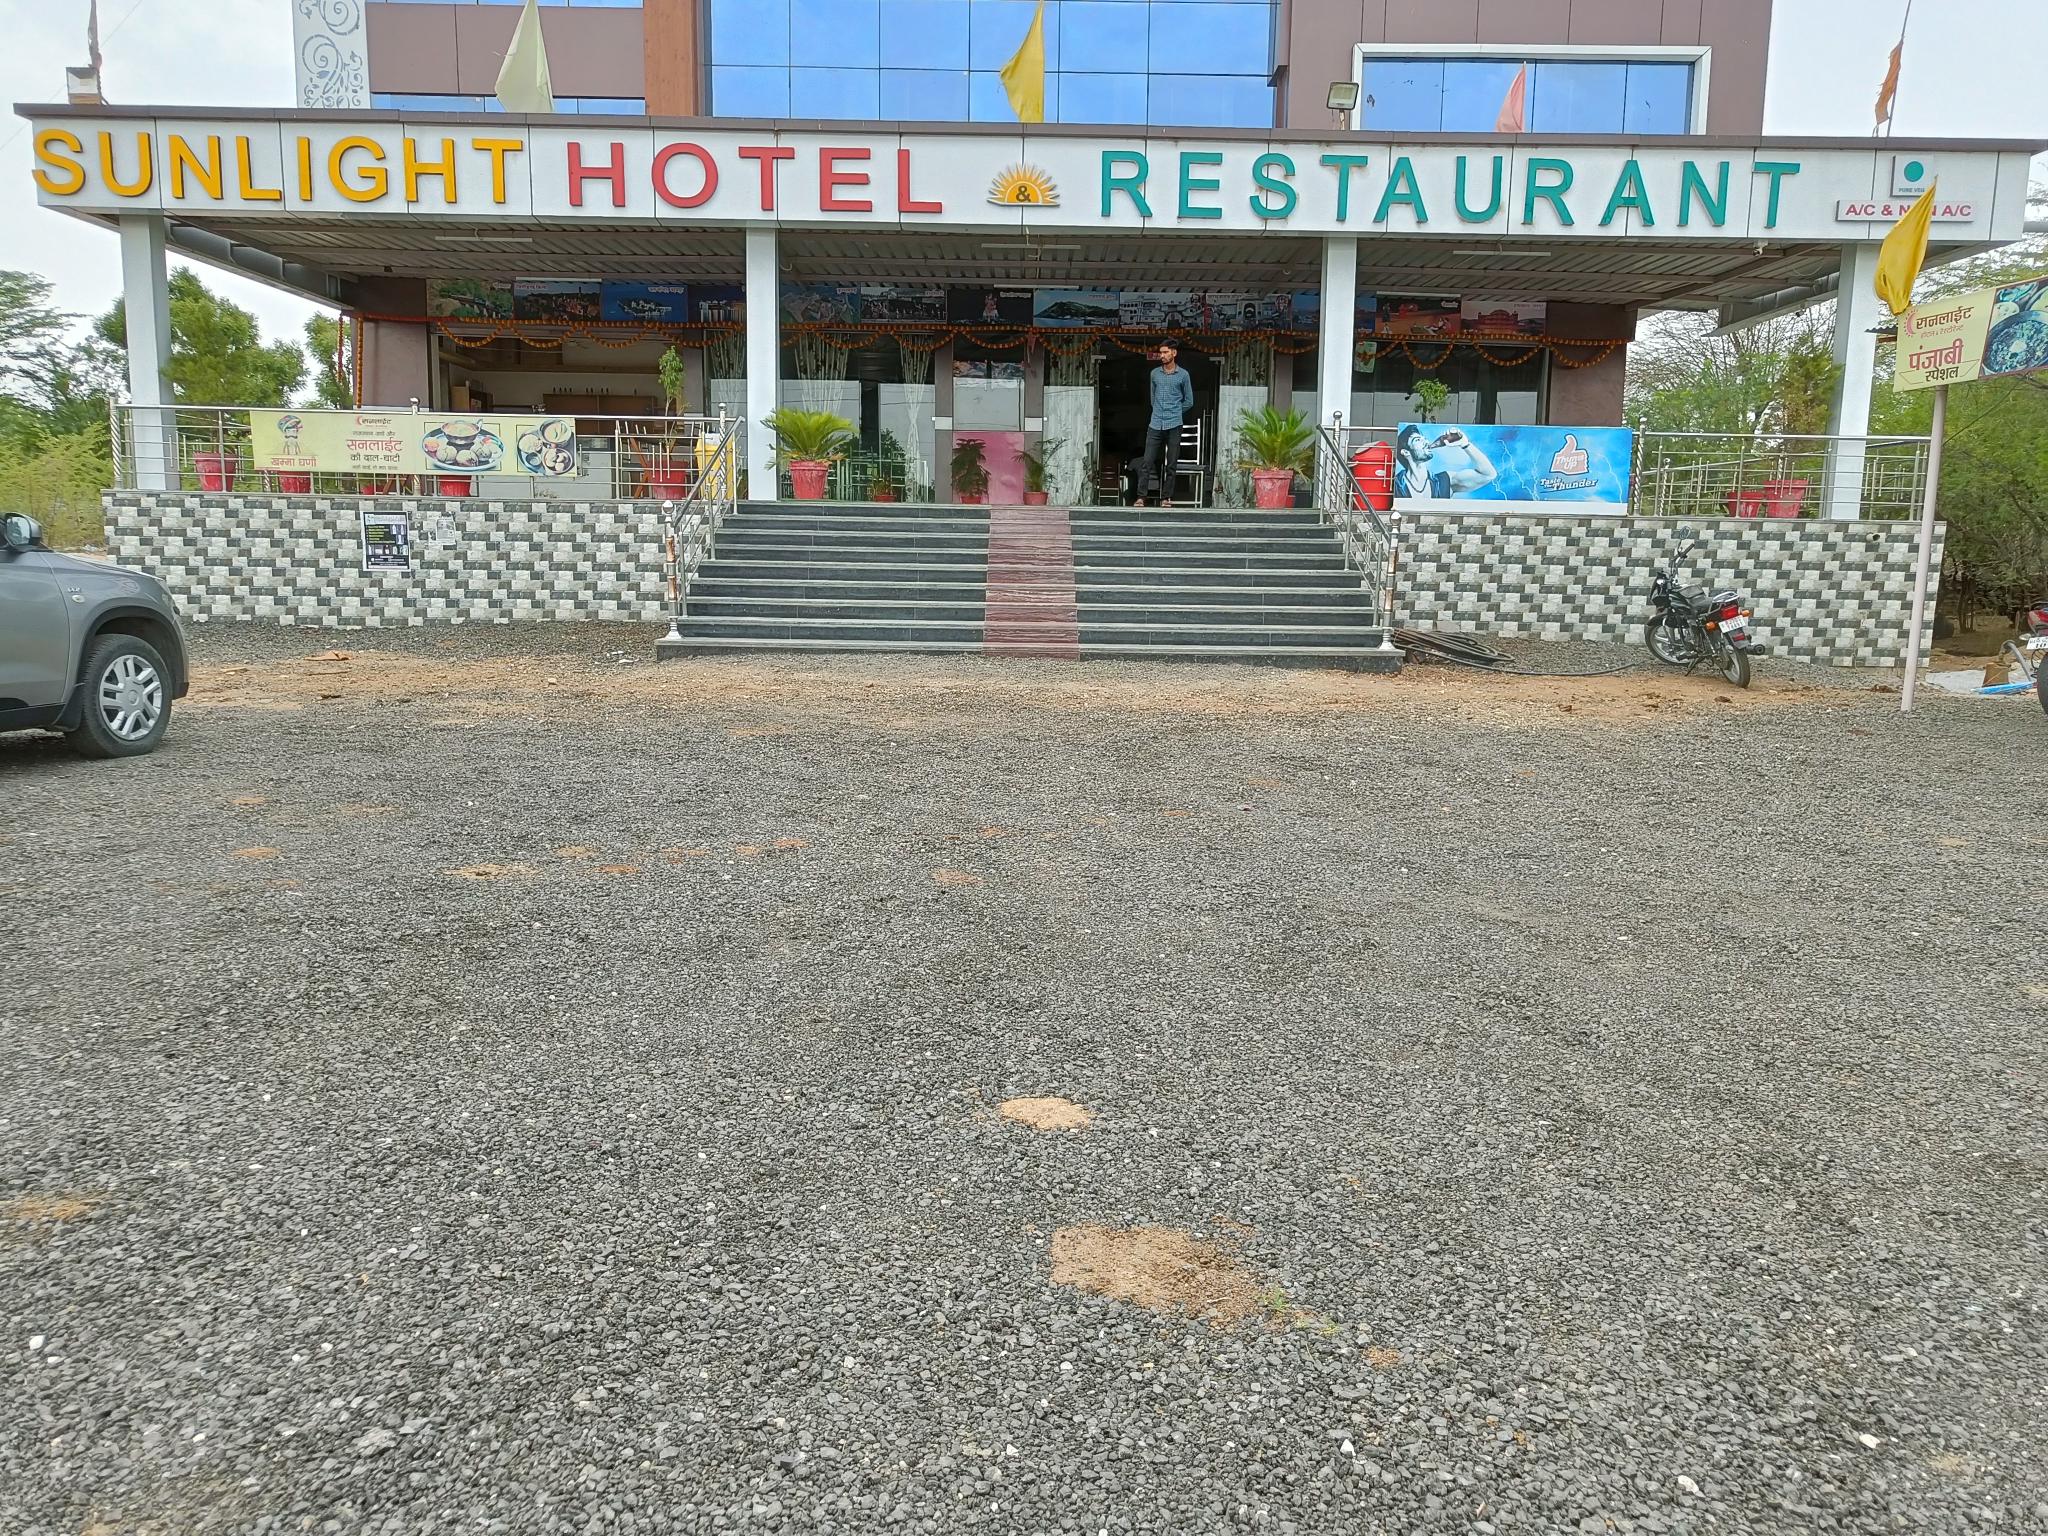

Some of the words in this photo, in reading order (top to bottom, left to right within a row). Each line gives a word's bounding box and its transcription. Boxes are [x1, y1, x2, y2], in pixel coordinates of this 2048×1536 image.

[32, 128, 524, 205] SUNLIGHT
[567, 141, 943, 214] HOTEL
[1016, 185, 1031, 203] &
[1100, 150, 1801, 229] RESTAURANT
[1845, 204, 1876, 216] A/C
[1880, 204, 1893, 216] &
[1941, 205, 1972, 217] A/C
[1916, 306, 1974, 330] सनलाईट
[1909, 338, 1964, 371] पंजाबी
[1925, 366, 1960, 382] स्पेशल
[346, 436, 404, 453] सनलाईट
[271, 457, 295, 466] खम्मा
[350, 452, 361, 461] की
[1553, 478, 1597, 491] Thunder
